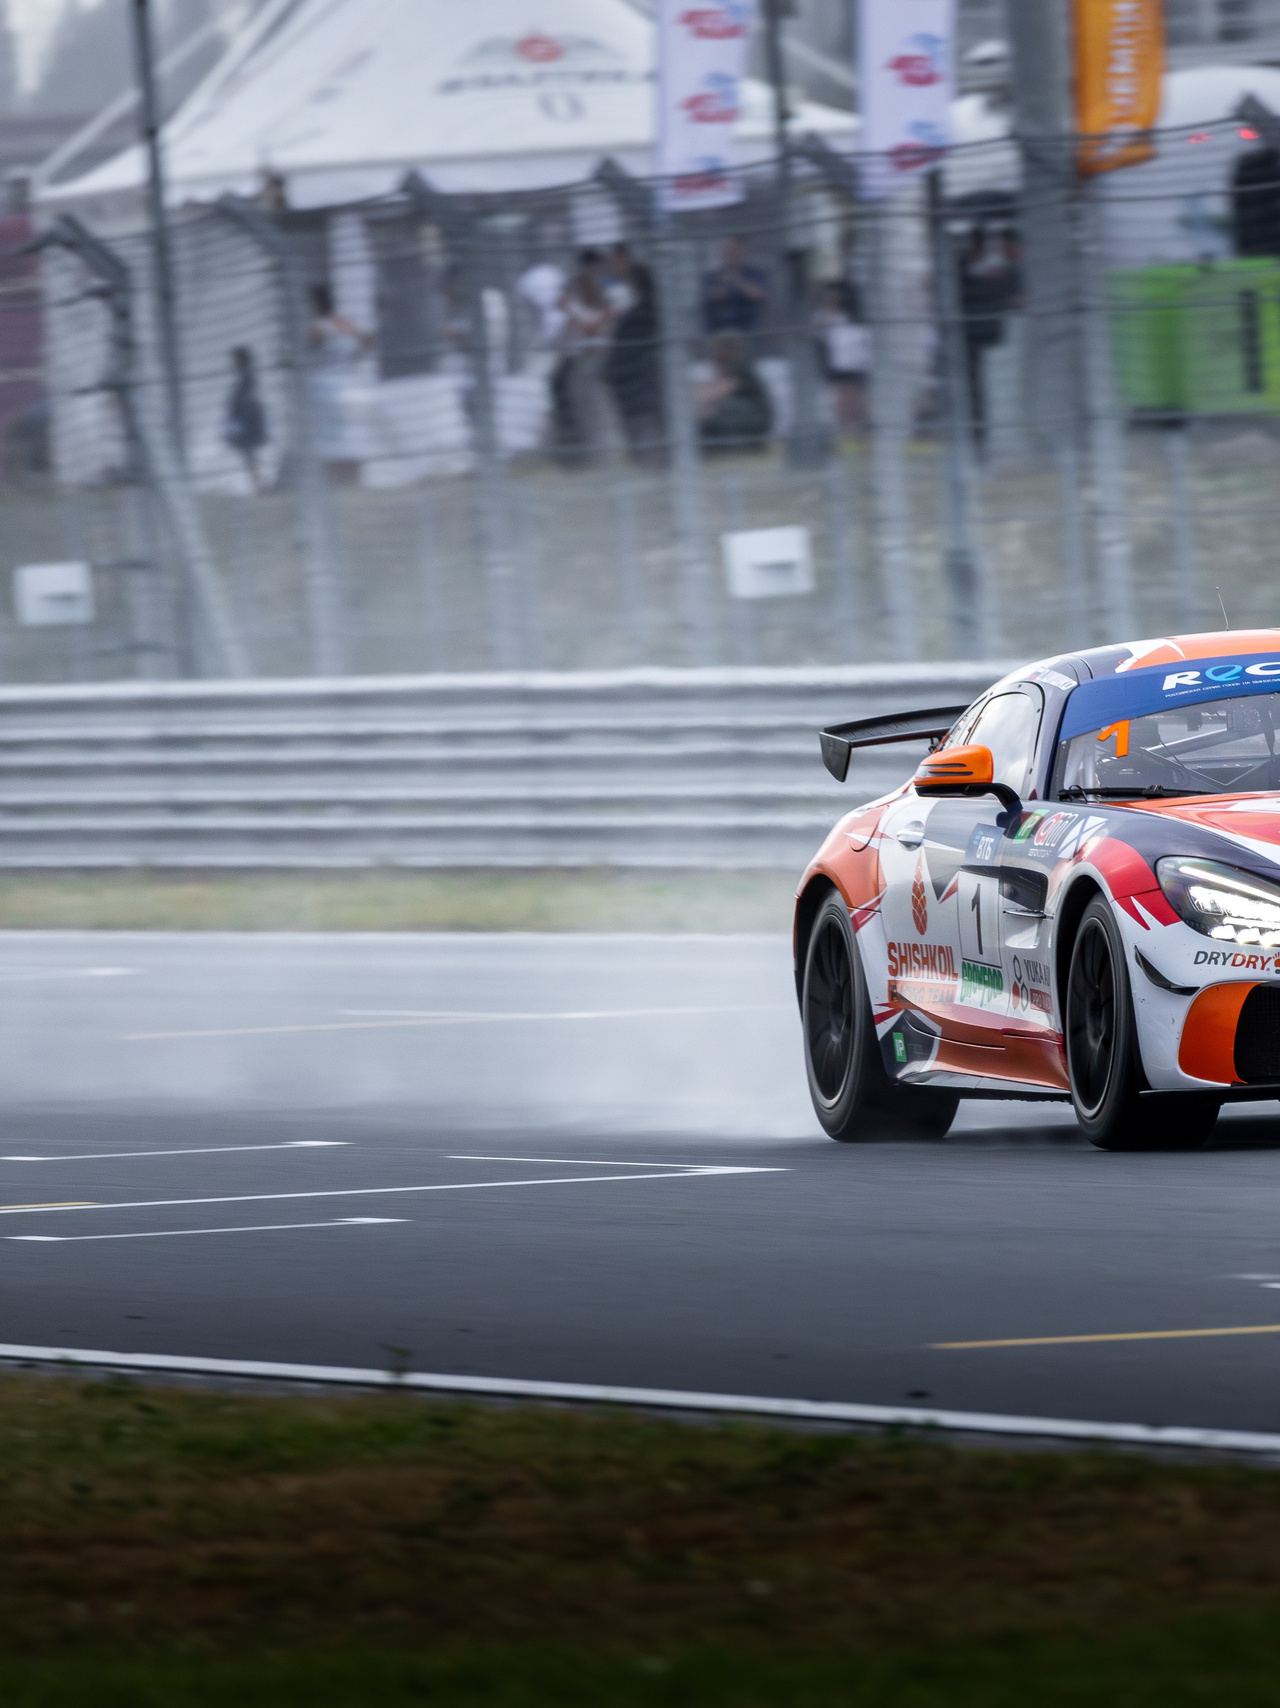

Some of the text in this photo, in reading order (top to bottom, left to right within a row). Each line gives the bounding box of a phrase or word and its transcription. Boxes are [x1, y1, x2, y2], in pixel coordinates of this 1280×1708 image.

[1097, 719, 1130, 758] 1
[971, 883, 984, 955] 1
[888, 942, 959, 981] SHISHKOIL
